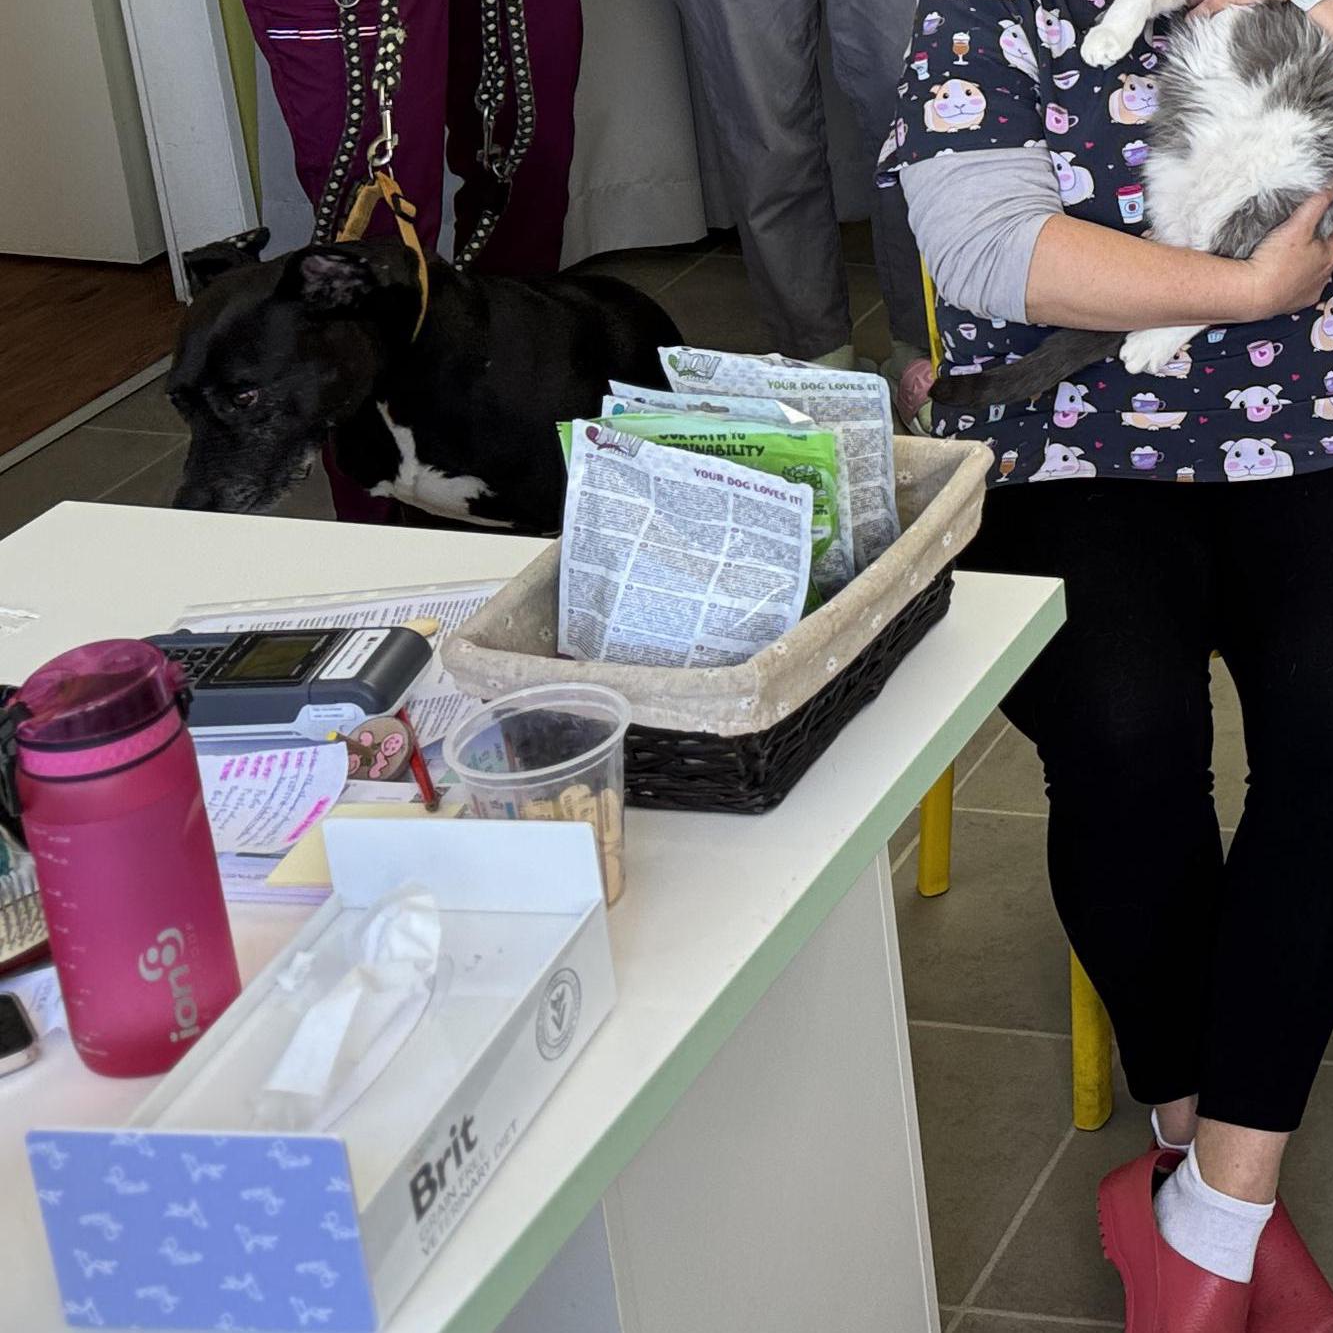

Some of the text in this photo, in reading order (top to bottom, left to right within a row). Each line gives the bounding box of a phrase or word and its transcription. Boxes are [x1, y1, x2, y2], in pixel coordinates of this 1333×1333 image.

[767, 380, 797, 391] YOUR
[801, 382, 825, 391] DOG
[828, 383, 863, 391] LOVES
[694, 468, 724, 483] YOUR
[727, 477, 751, 490] DOG
[753, 484, 786, 501] LOVES
[409, 1114, 479, 1224] Brit
